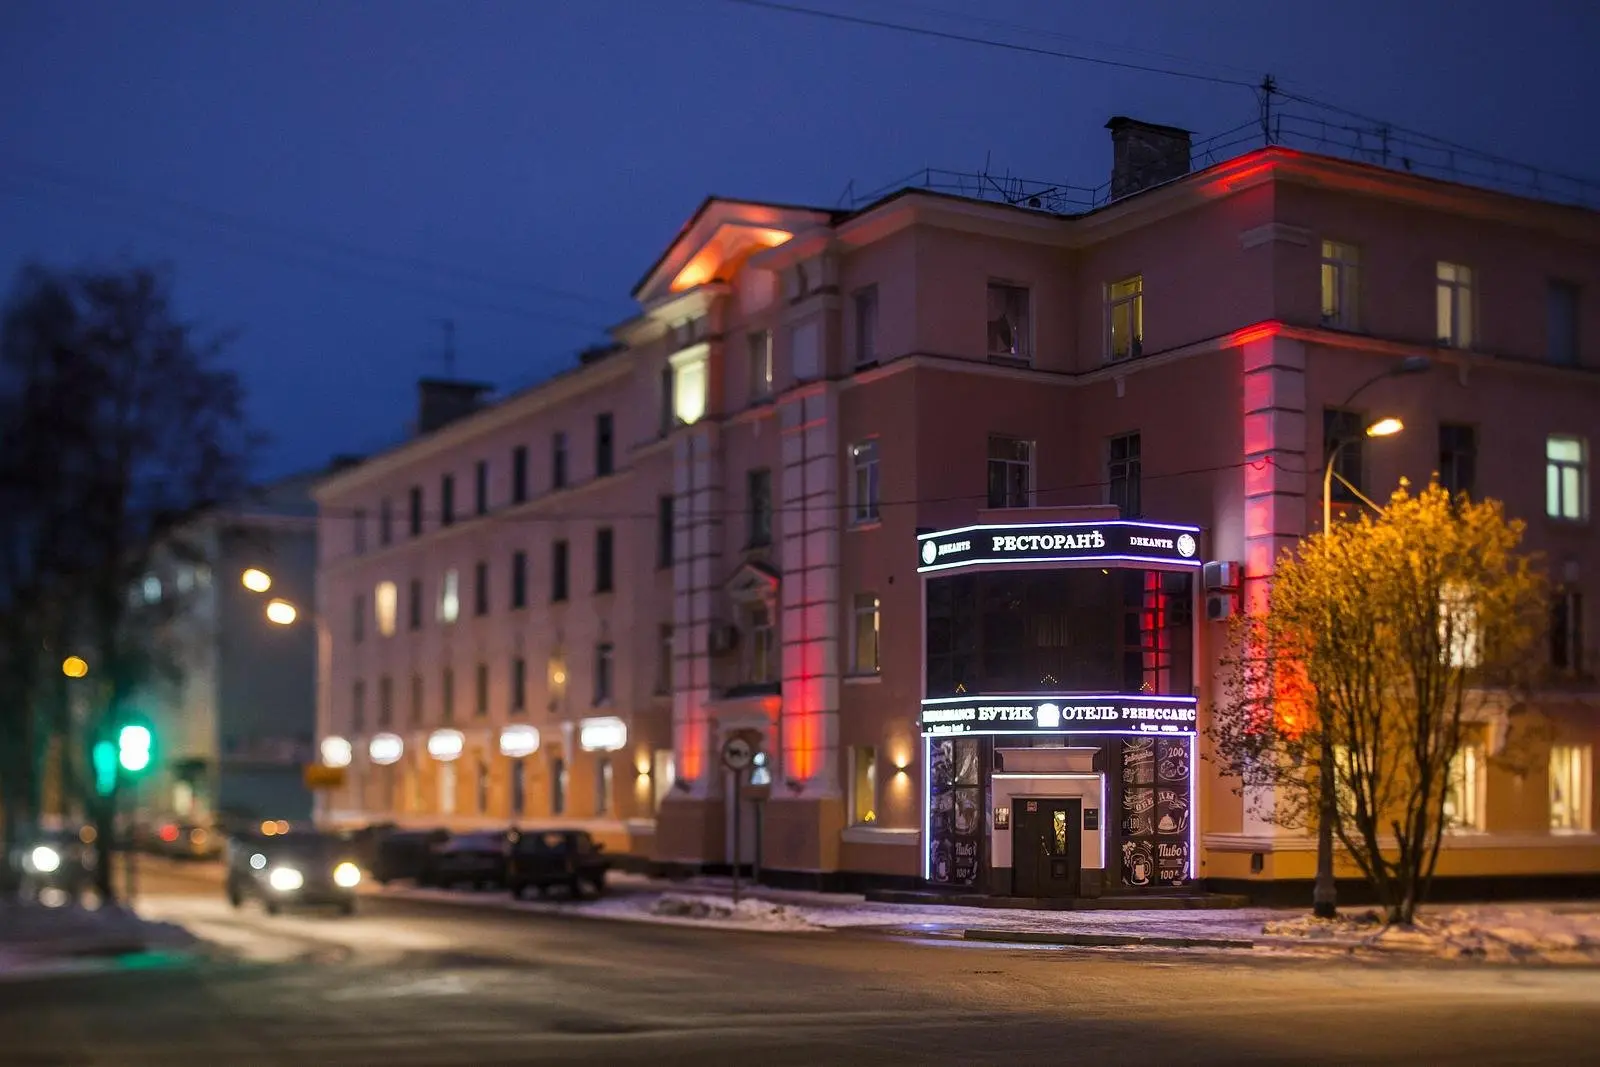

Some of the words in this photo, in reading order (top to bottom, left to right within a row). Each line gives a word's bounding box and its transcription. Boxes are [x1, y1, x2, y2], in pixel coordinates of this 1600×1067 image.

[1129, 536, 1174, 549] DEKANTE
[977, 706, 1034, 721] БУТИК
[1062, 706, 1119, 721] ОТЕЛЬ
[1121, 707, 1196, 721] РЕНЕССАНС
[1168, 747, 1184, 758] 200
[1159, 843, 1182, 857] Пиво
[1160, 870, 1174, 880] 100
